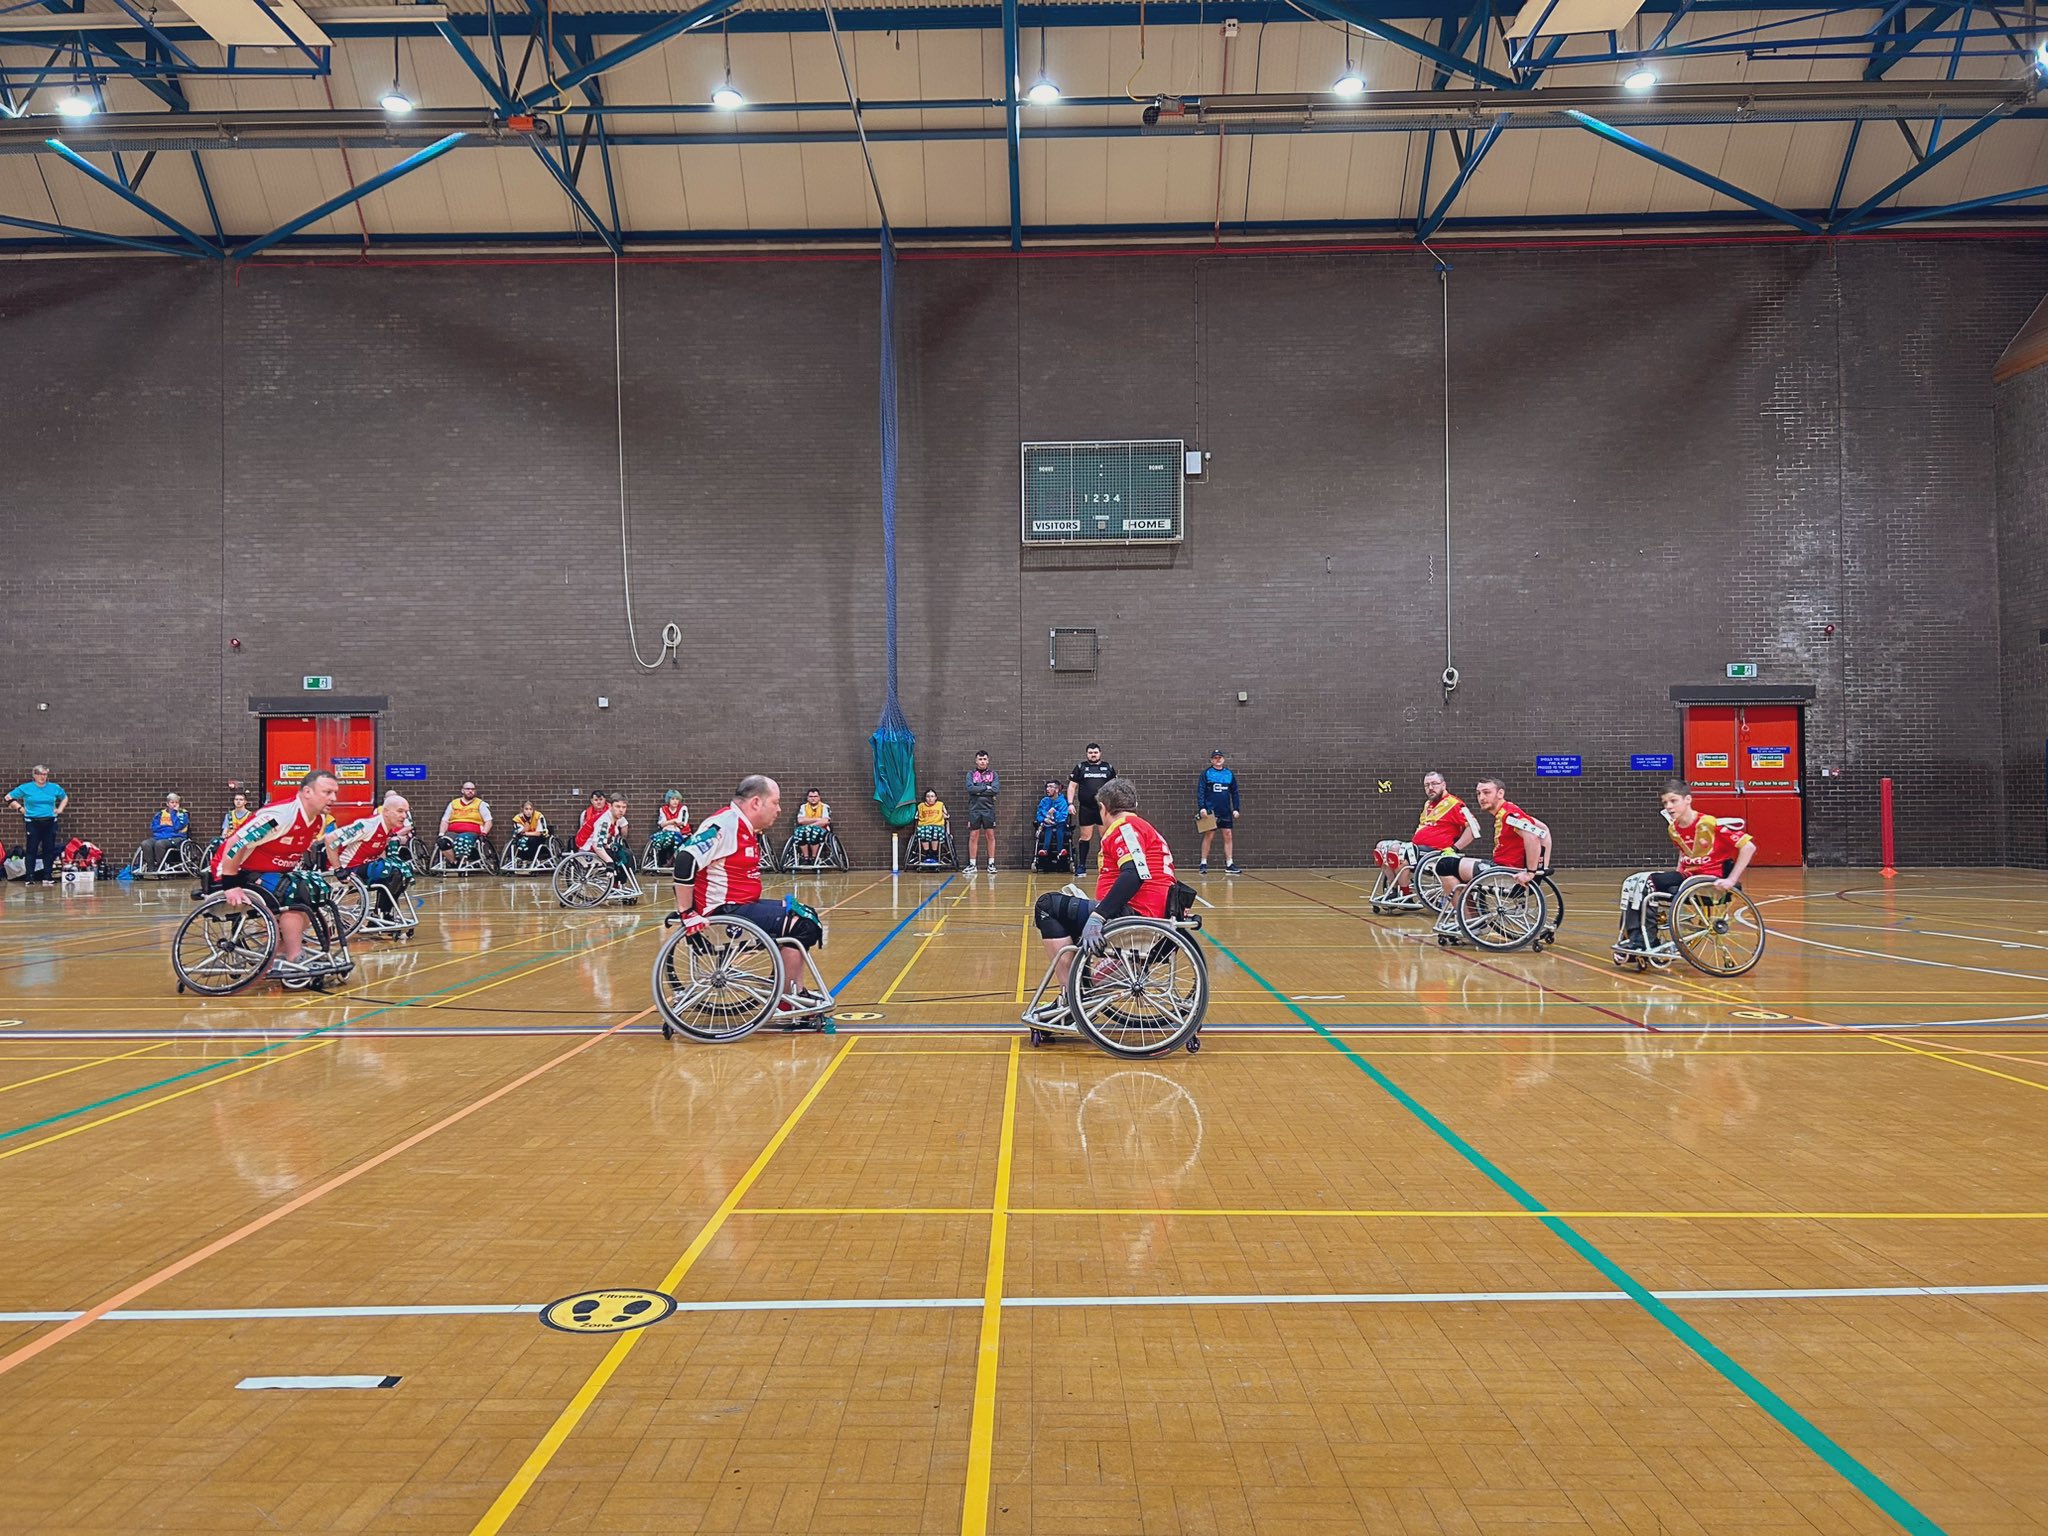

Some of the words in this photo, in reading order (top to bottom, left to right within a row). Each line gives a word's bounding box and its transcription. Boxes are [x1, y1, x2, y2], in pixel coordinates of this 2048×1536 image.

[1084, 494, 1088, 502] 1
[1093, 494, 1099, 502] 2
[1103, 494, 1110, 502] 3
[1113, 494, 1120, 502] 4
[1035, 522, 1078, 531] VISITORS
[1129, 520, 1165, 529] HOME
